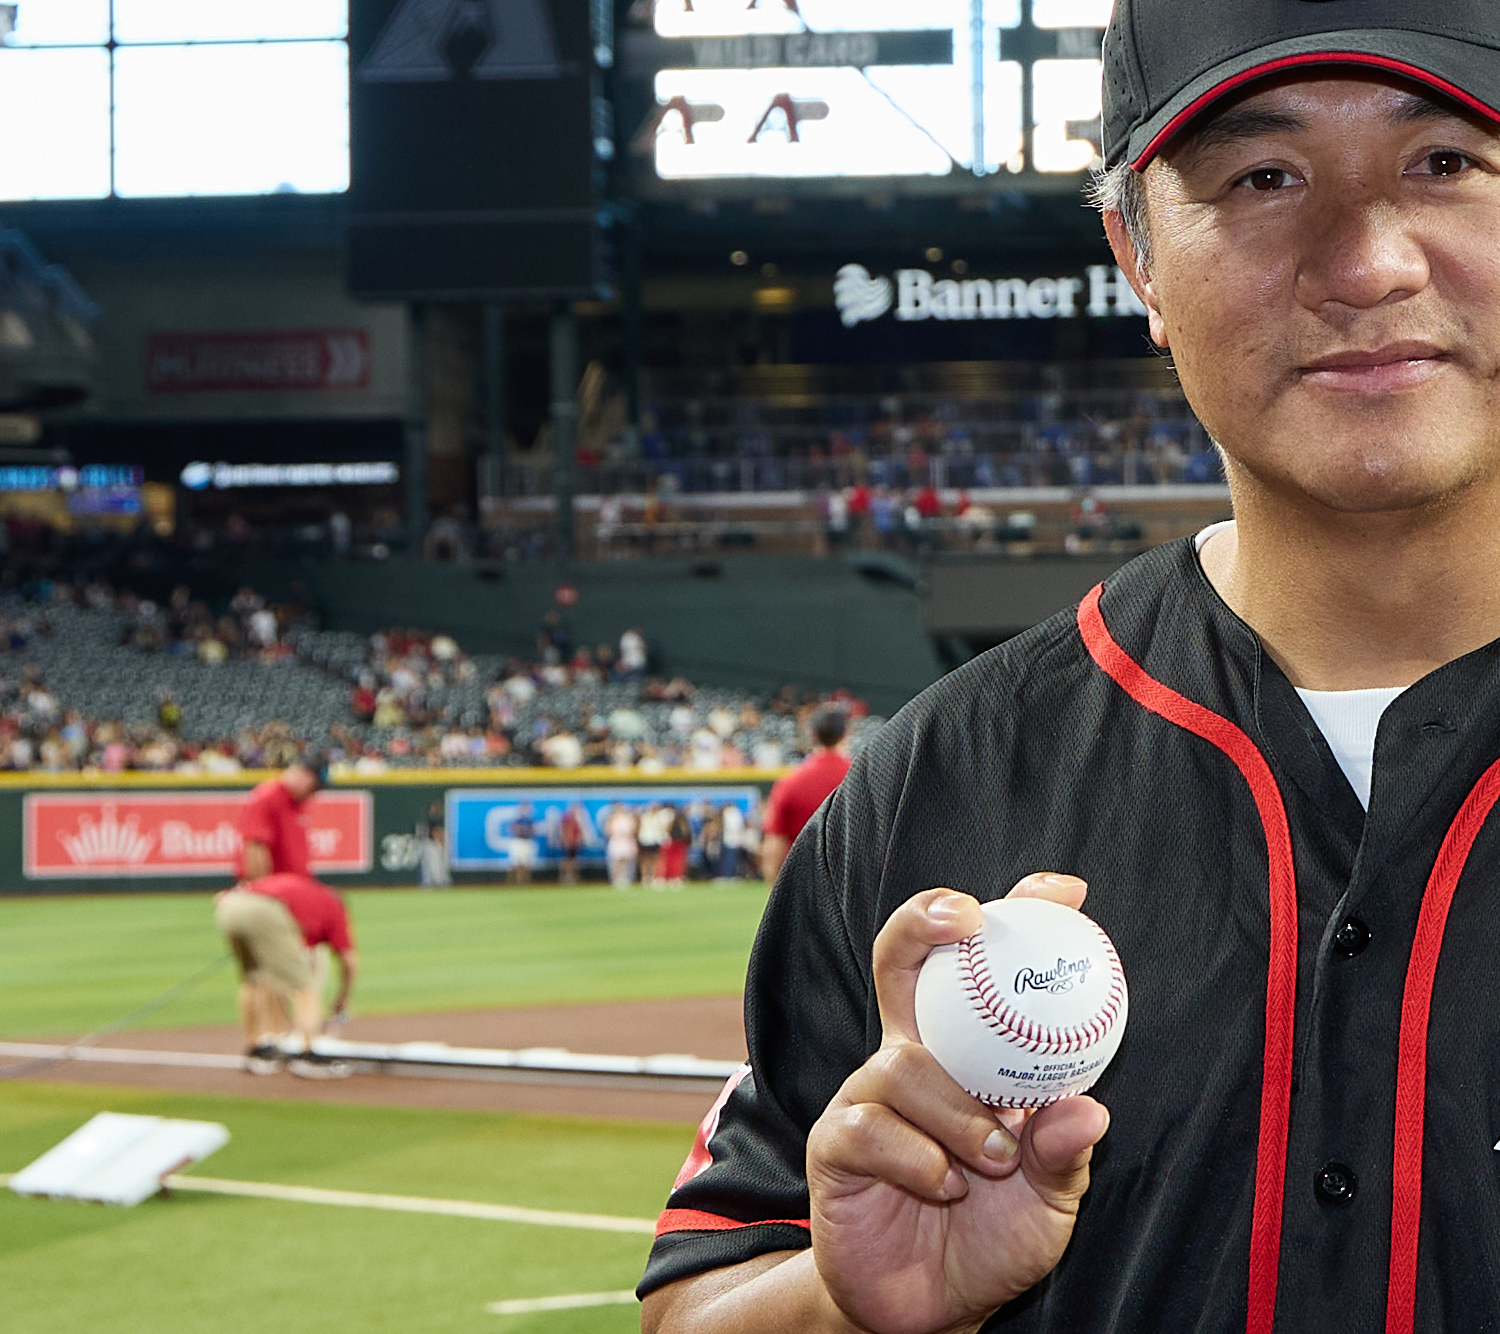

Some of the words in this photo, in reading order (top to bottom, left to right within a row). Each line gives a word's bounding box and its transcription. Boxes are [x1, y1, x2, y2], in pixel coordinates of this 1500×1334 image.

[895, 268, 1082, 320] Banner
[1015, 957, 1092, 994] Rawlings
[998, 1068, 1035, 1081] MAJOR
[1036, 1071, 1068, 1081] LEAGUE
[1069, 1057, 1105, 1078] BASEBALL
[1043, 1061, 1076, 1072] OFFICIAL
